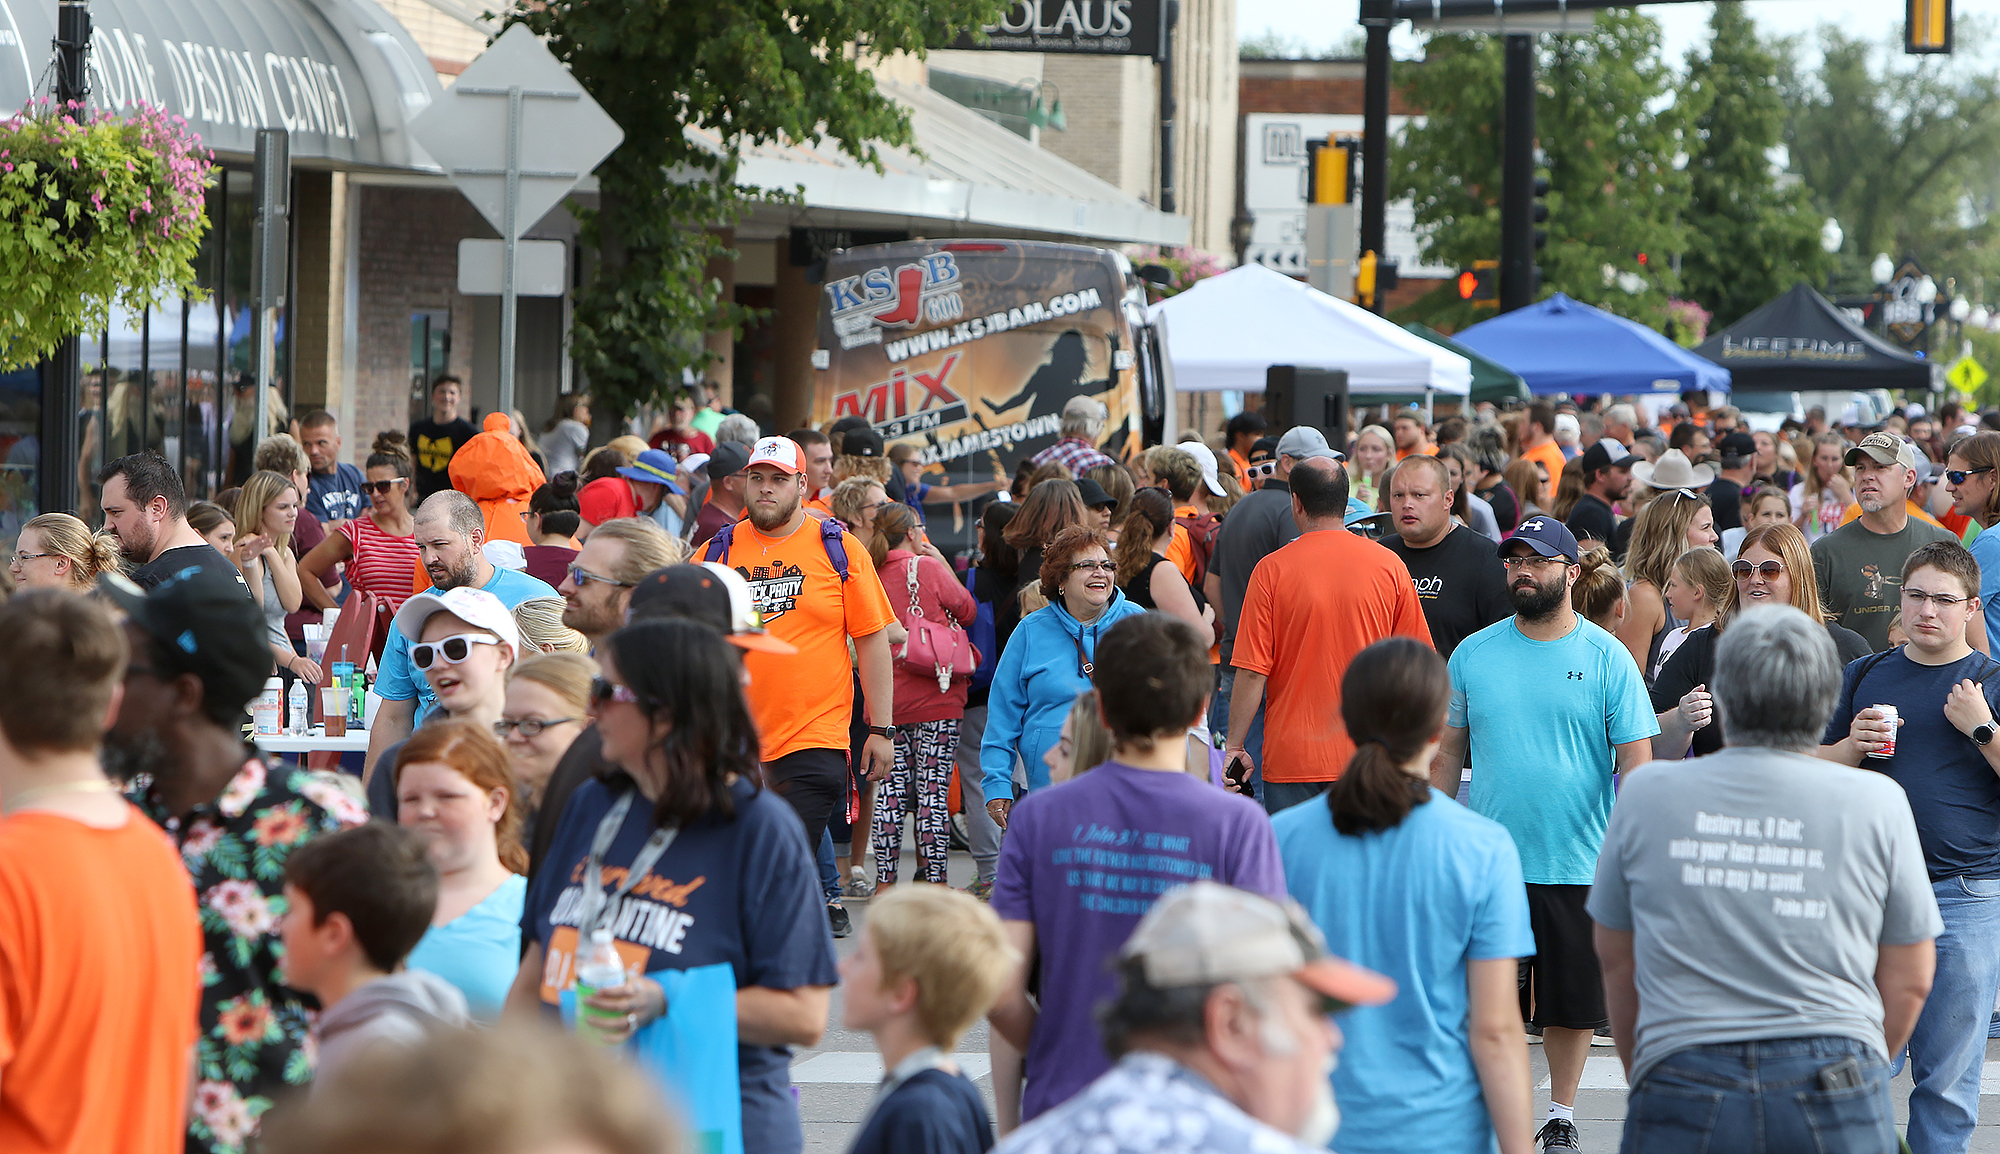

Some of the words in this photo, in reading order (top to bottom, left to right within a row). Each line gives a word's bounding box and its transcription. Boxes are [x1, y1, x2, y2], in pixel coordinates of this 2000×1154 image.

[925, 292, 963, 325] 600
[885, 288, 1102, 363] WWW.KSJBAM.COM
[1722, 333, 1867, 356] LIFETIME
[907, 412, 941, 433] FM
[769, 581, 802, 598] PARTY
[1854, 605, 1891, 614] UNDER
[1162, 834, 1192, 853] WHAT
[1066, 869, 1081, 887] US
